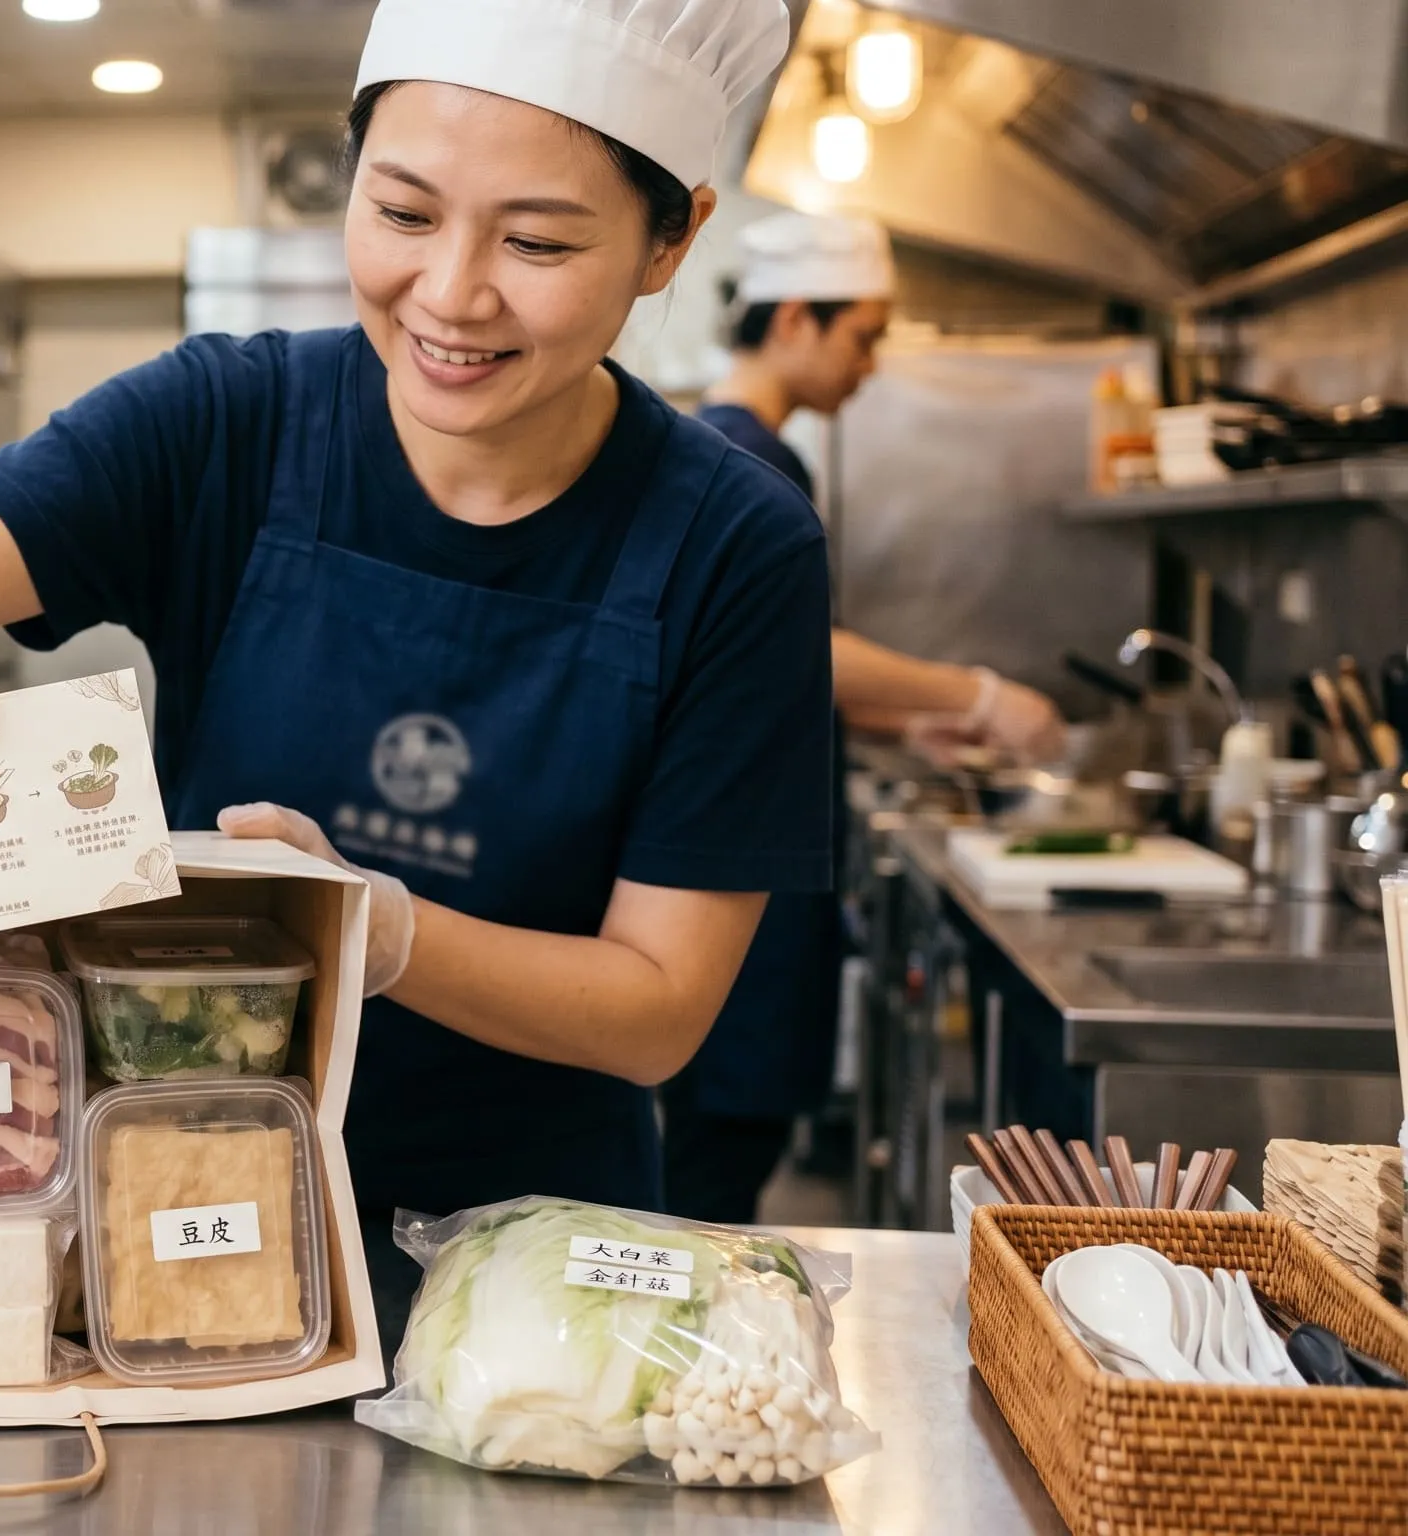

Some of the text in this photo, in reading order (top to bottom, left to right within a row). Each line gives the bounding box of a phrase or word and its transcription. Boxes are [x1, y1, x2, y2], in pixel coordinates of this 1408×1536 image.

[179, 1216, 235, 1246] 豆皮
[588, 1243, 672, 1266] 大白菜
